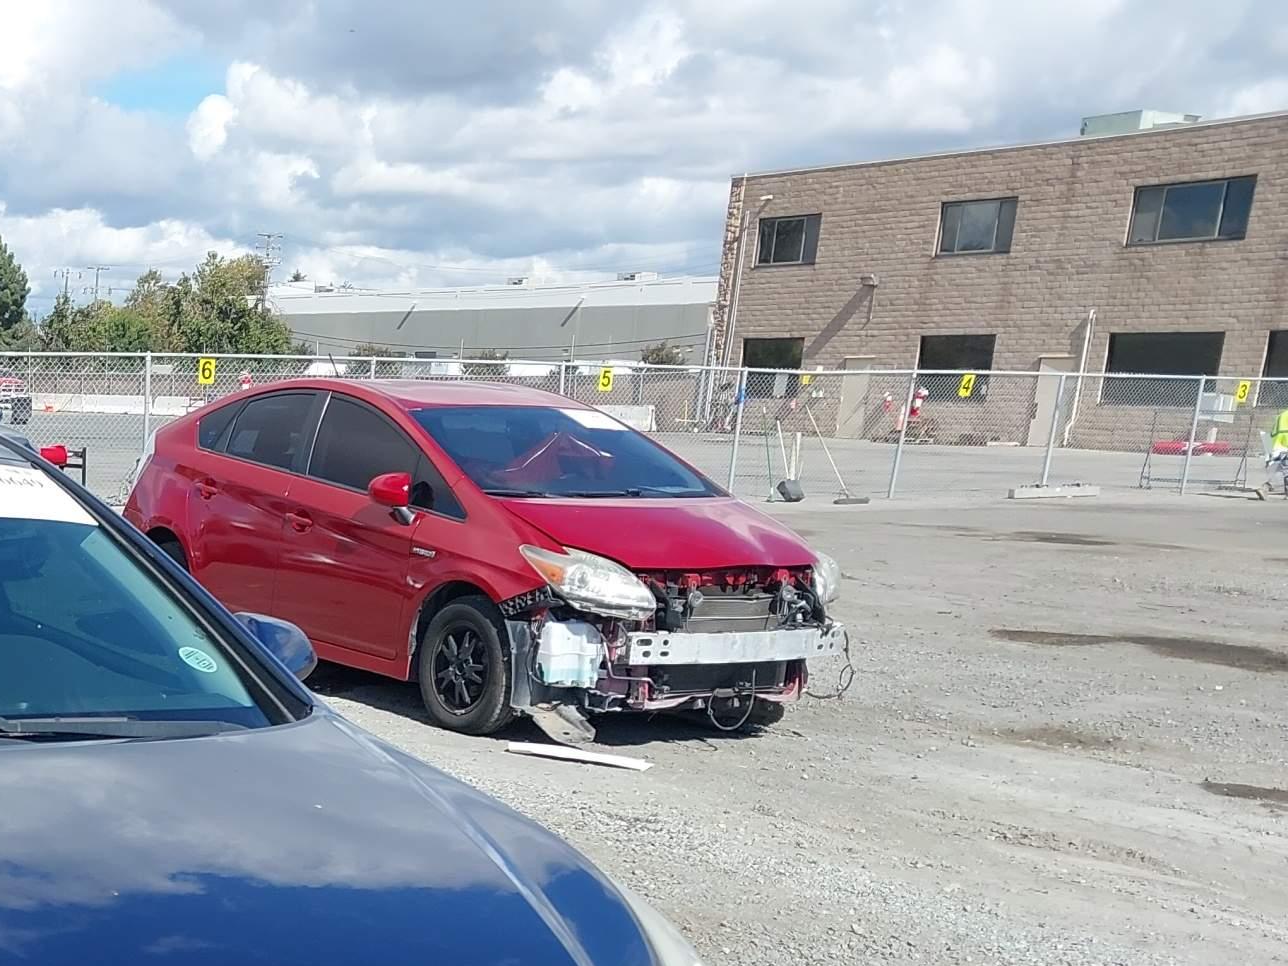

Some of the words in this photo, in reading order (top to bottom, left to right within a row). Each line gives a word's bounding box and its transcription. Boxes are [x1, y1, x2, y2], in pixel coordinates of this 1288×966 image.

[202, 361, 212, 379] 6
[601, 370, 611, 387] 5
[962, 377, 973, 393] 4
[1238, 384, 1248, 399] 3
